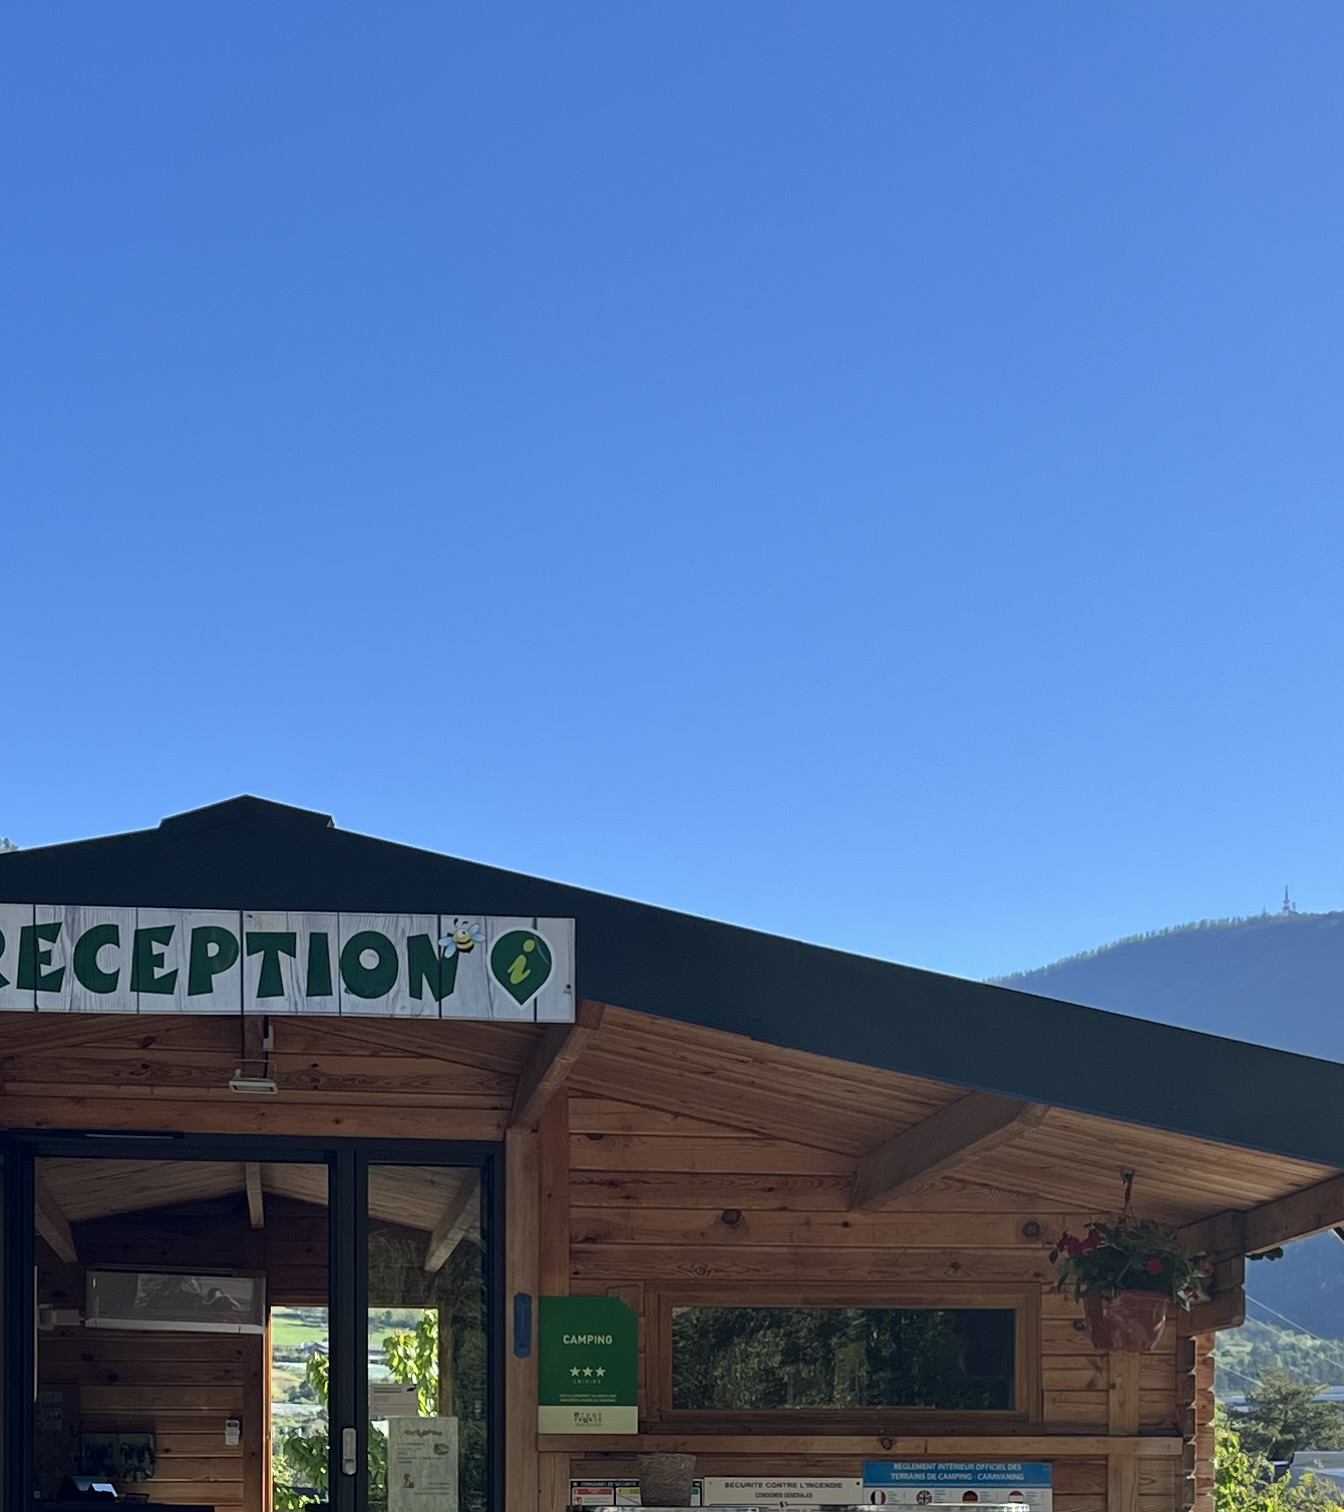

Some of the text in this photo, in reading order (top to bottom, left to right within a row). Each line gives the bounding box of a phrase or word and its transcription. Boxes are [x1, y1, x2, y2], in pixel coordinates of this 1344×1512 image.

[562, 1334, 614, 1345] CAMPING
[1007, 1463, 1023, 1471] DES
[926, 1472, 937, 1481] DE
[937, 1472, 973, 1481] CAMPING
